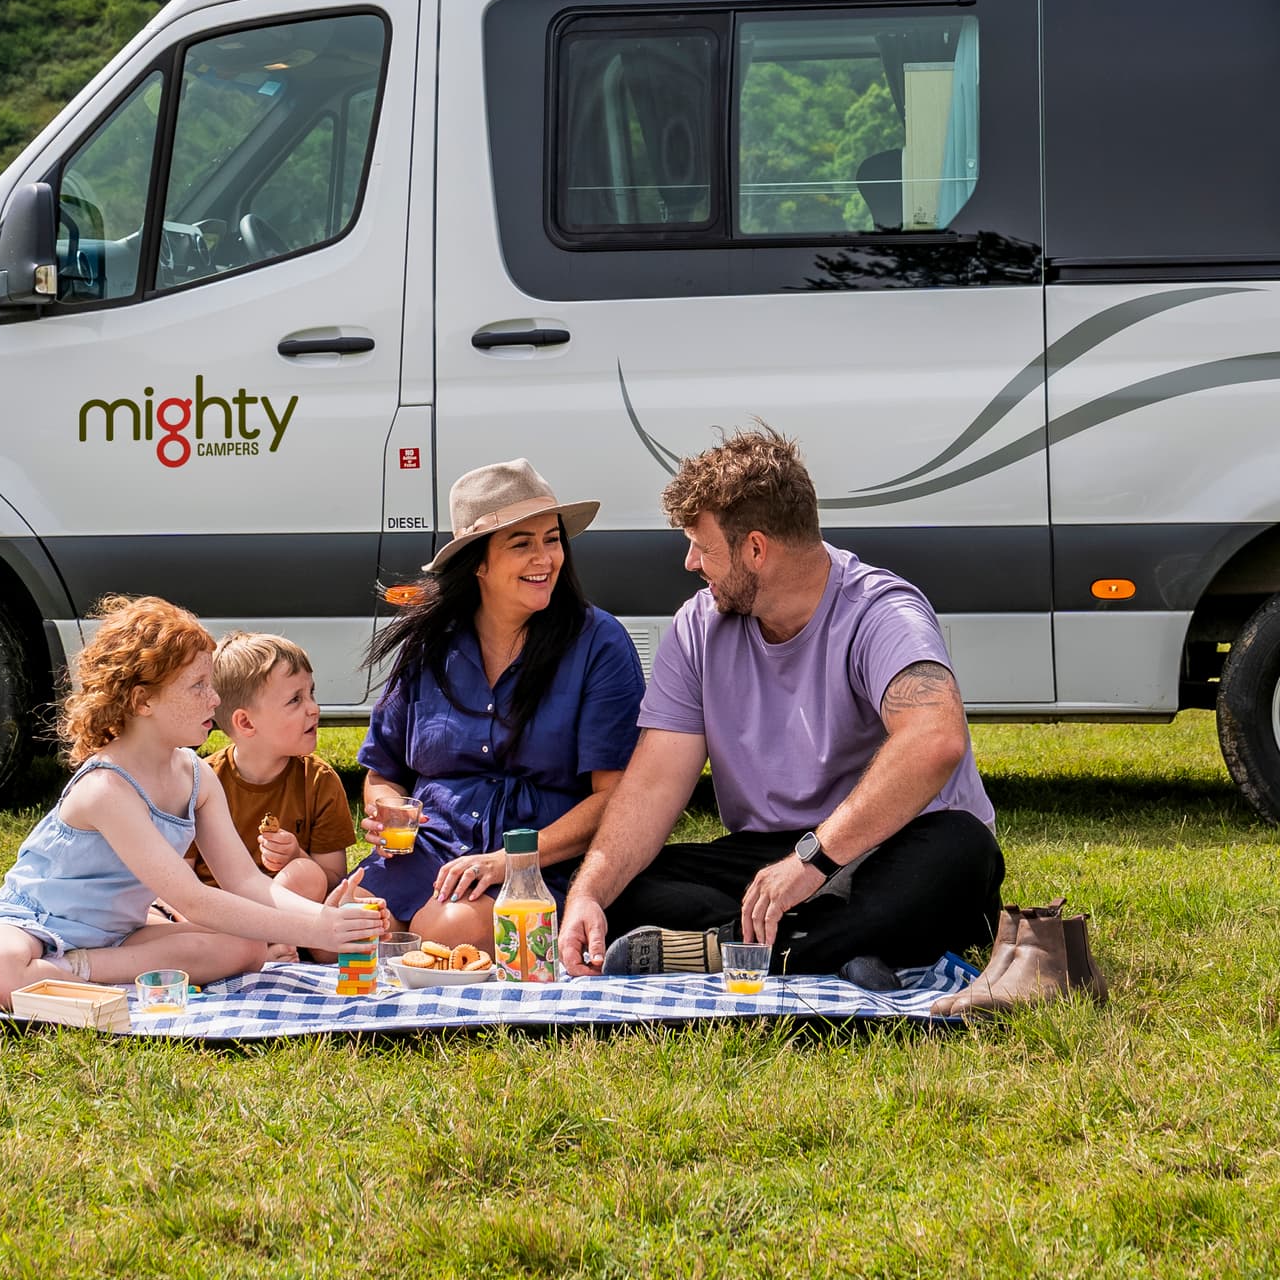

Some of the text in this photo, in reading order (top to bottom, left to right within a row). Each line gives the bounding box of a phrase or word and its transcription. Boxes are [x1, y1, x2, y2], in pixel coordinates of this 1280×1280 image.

[79, 375, 299, 468] mighty
[197, 442, 259, 457] CAMPERS
[387, 517, 429, 529] DIESEL
